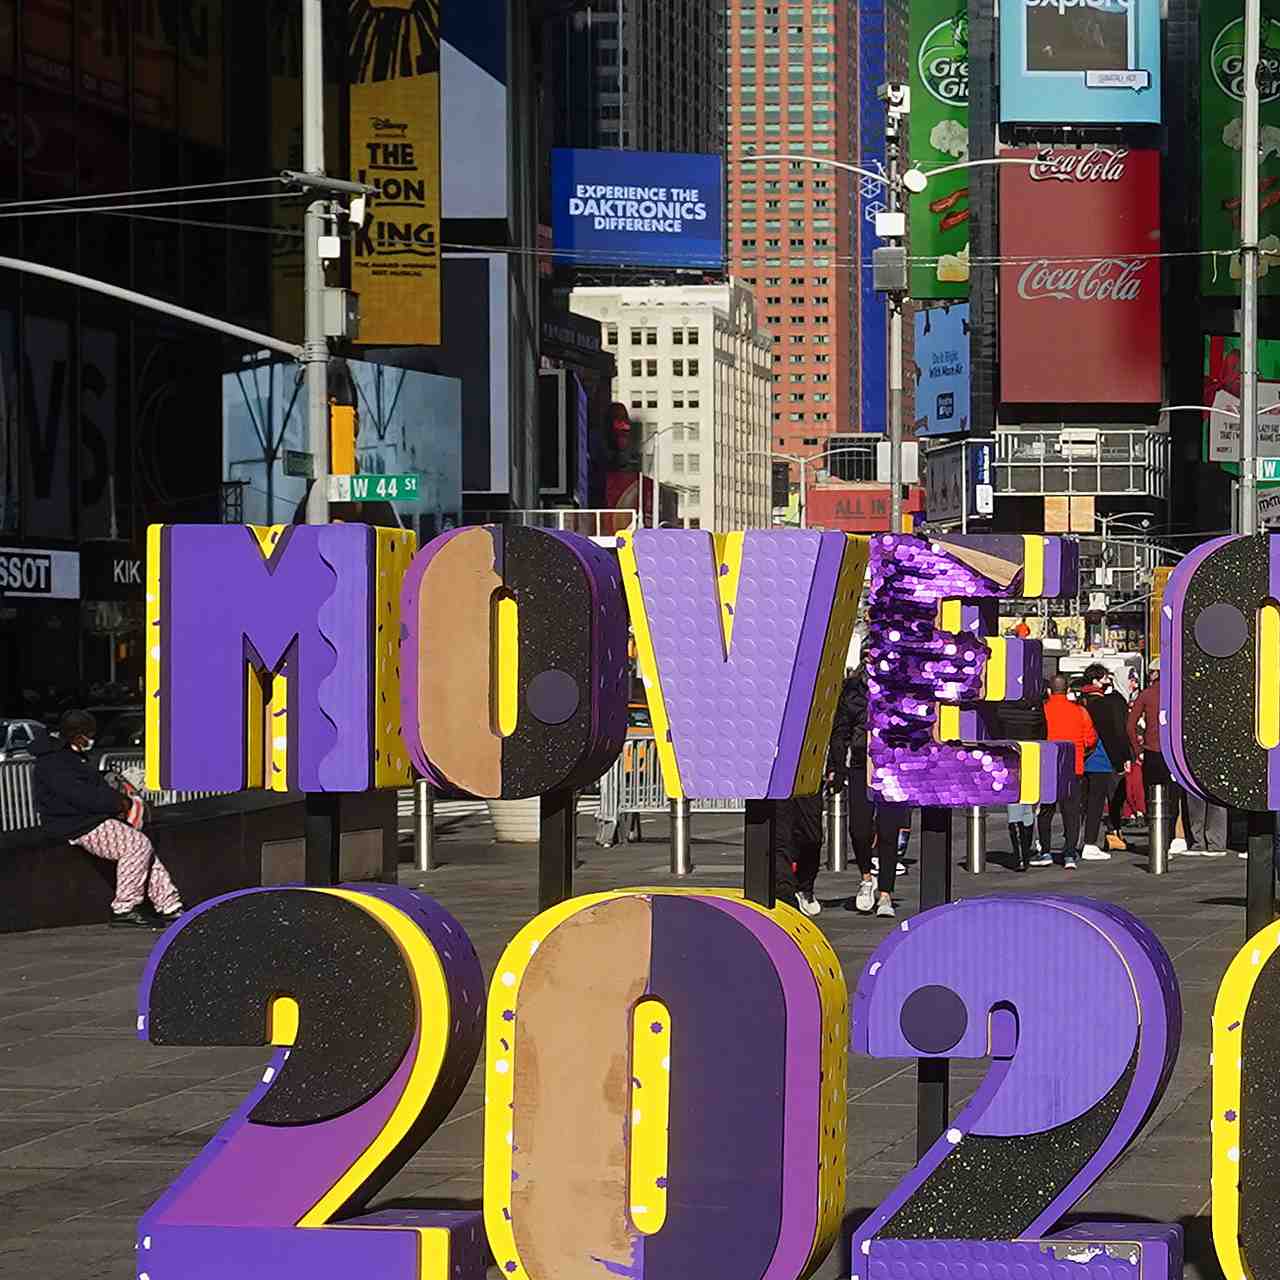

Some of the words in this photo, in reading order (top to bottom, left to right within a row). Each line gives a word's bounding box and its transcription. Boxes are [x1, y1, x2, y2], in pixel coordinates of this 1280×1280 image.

[370, 116, 408, 132] Disney
[366, 143, 414, 165] THE
[576, 184, 666, 201] EXPERIENCE
[670, 188, 698, 202] THE
[568, 198, 707, 220] DAKTRONICS
[355, 212, 435, 257] KING
[594, 217, 682, 233] DIFFERENCE
[1264, 461, 1276, 477] W
[353, 478, 369, 498] W
[376, 478, 398, 497] 44
[404, 478, 417, 491] St
[835, 497, 862, 513] ALL
[871, 498, 885, 513] IN
[145, 523, 1077, 807] MOVE
